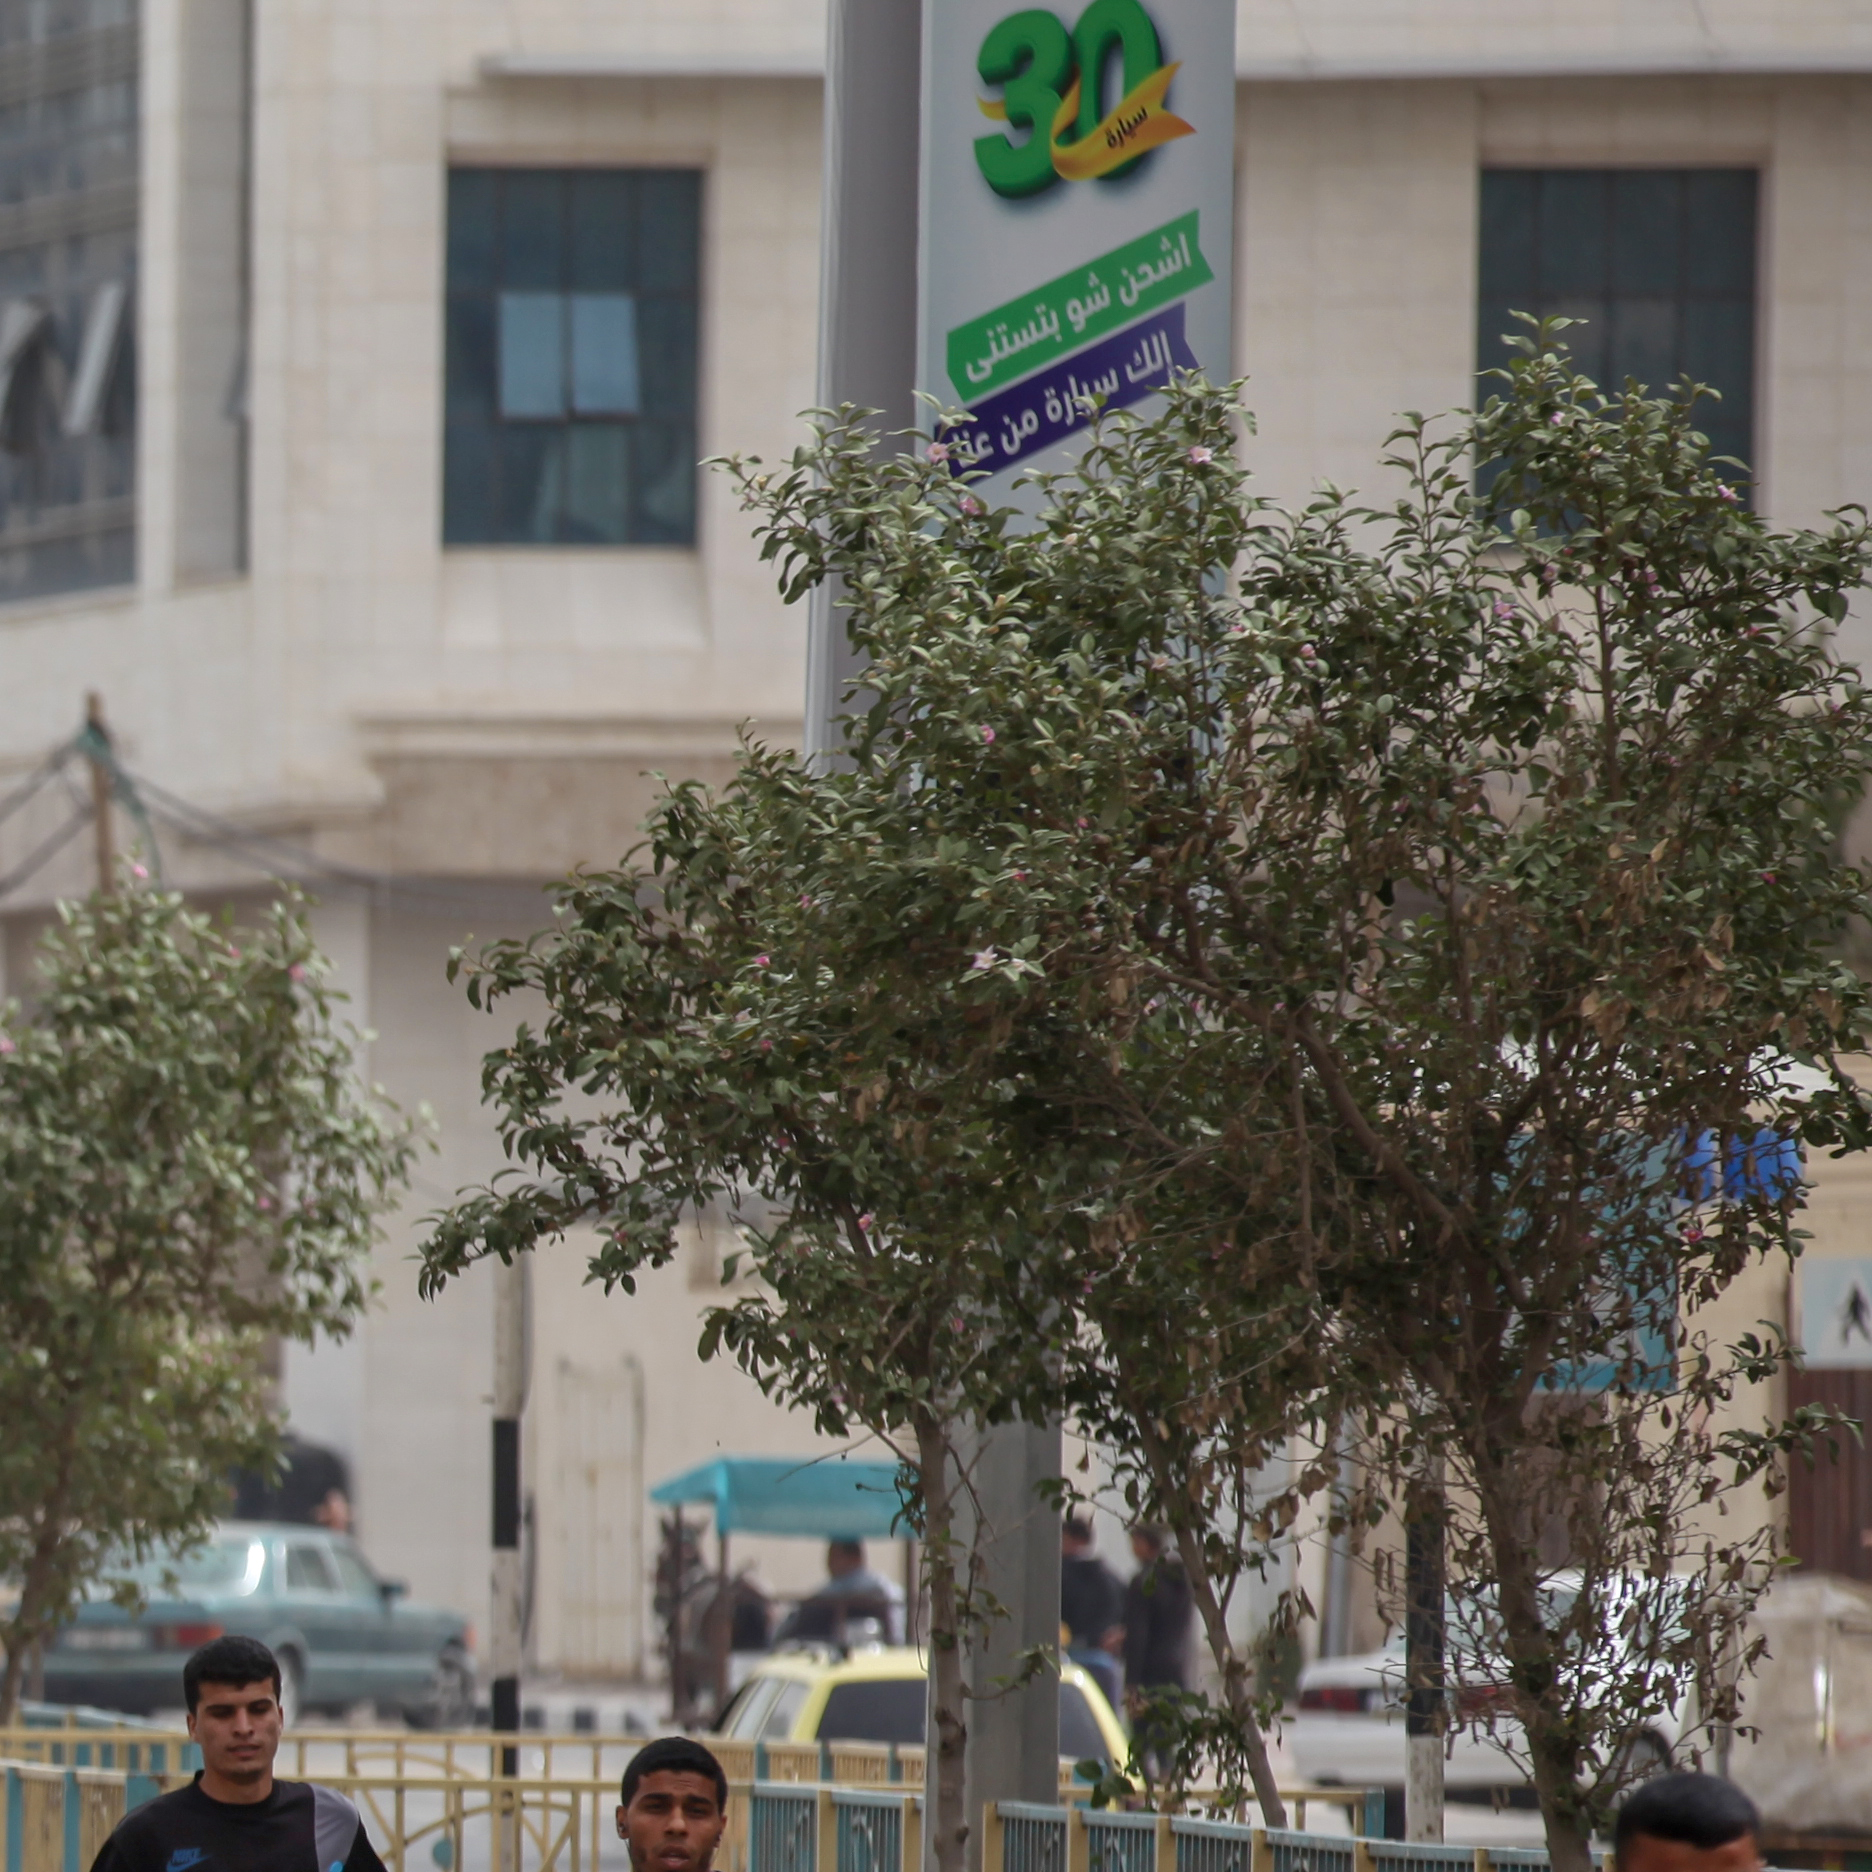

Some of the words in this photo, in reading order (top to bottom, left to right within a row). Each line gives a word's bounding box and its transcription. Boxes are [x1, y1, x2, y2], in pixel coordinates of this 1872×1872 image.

[974, 0, 1163, 199] 30
[1104, 105, 1149, 148] سيارة
[1119, 232, 1192, 307] اشحن
[1065, 271, 1112, 333] شو
[965, 303, 1062, 383] بتستنى
[1044, 368, 1119, 426] سيارة
[1001, 409, 1039, 455] من
